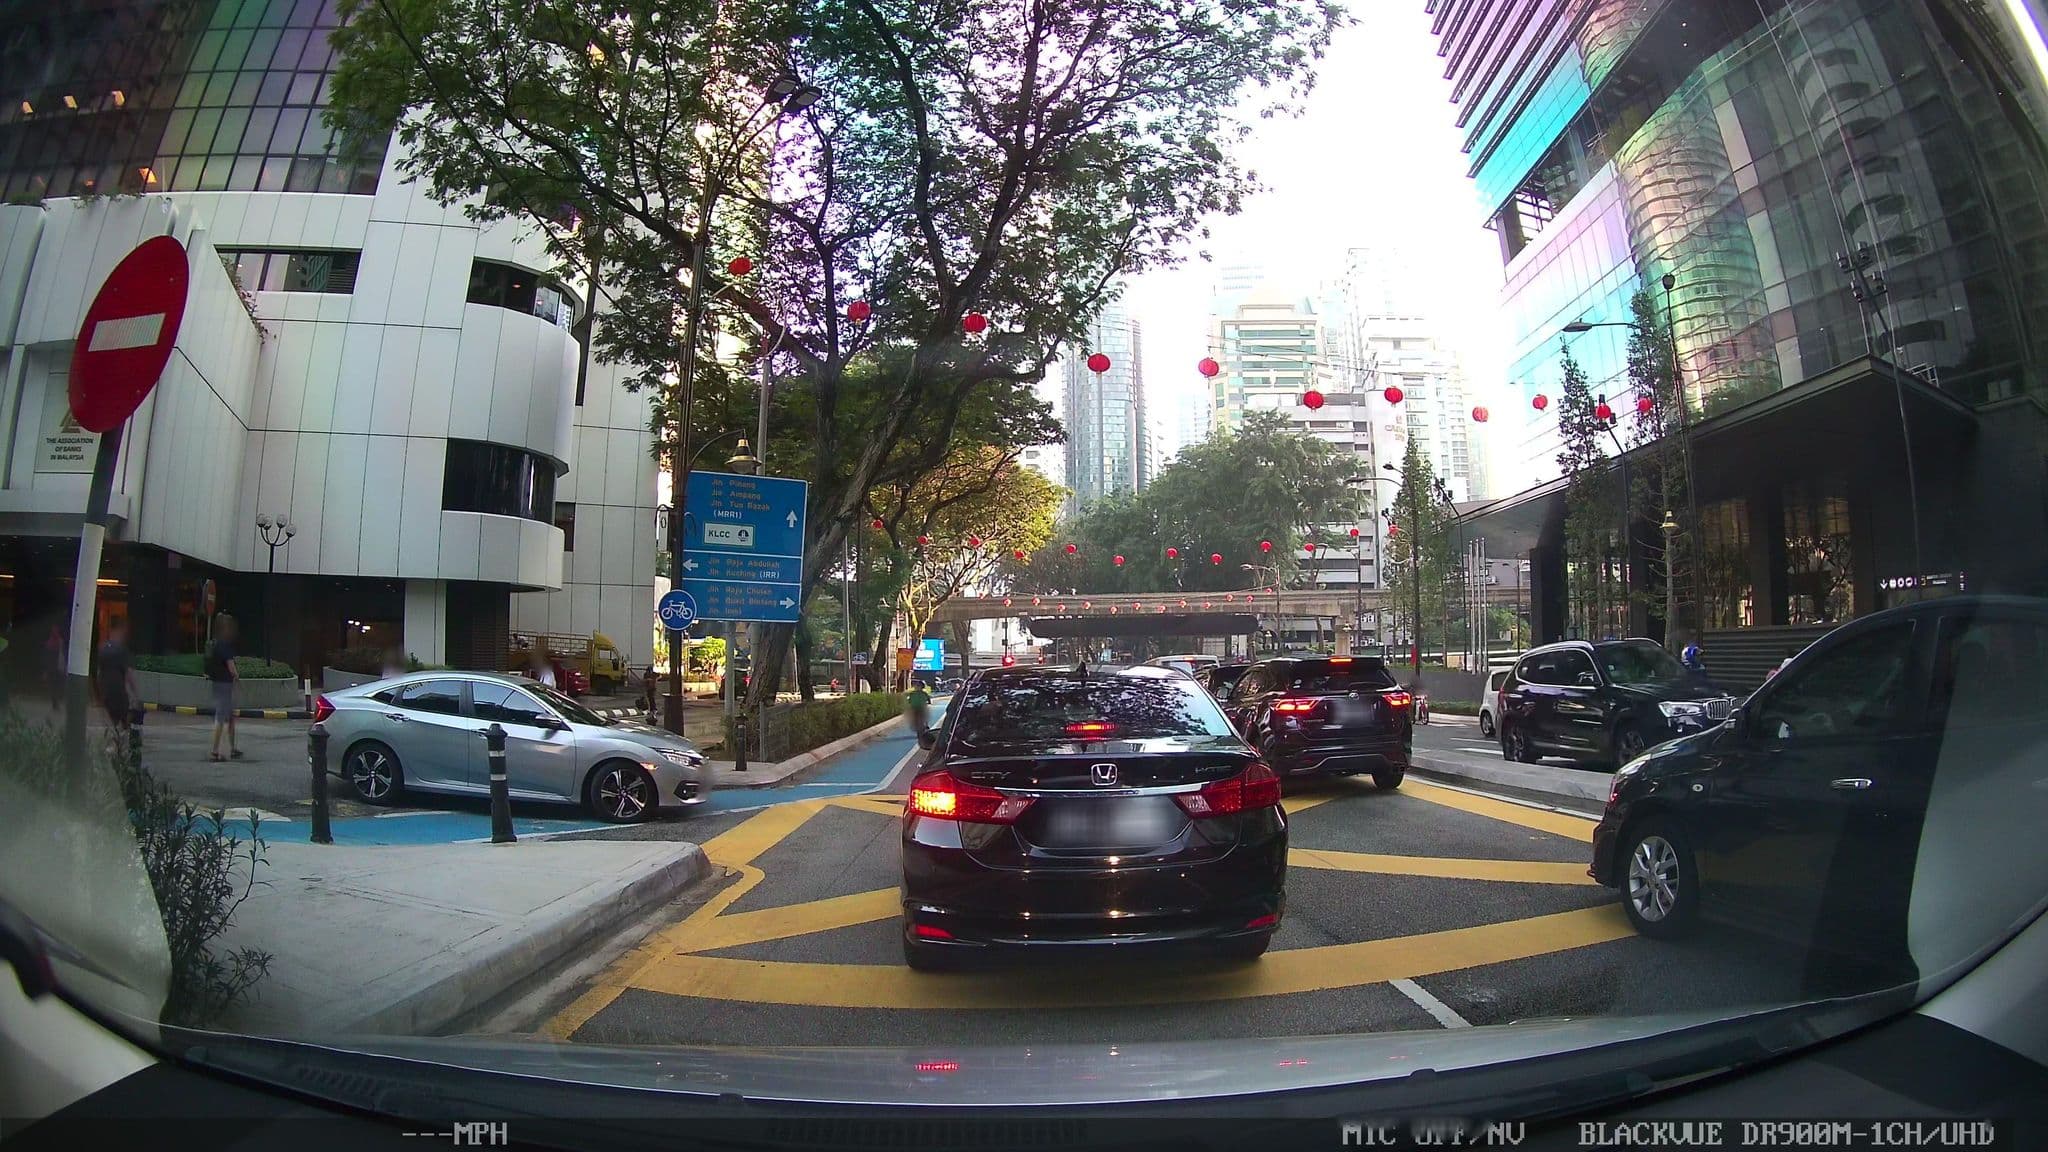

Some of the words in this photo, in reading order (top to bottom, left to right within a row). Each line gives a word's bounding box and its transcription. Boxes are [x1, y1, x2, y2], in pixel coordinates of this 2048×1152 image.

[713, 509, 742, 520] (MRR1)
[708, 530, 731, 538] KLCC
[759, 571, 780, 579] (IRR)
